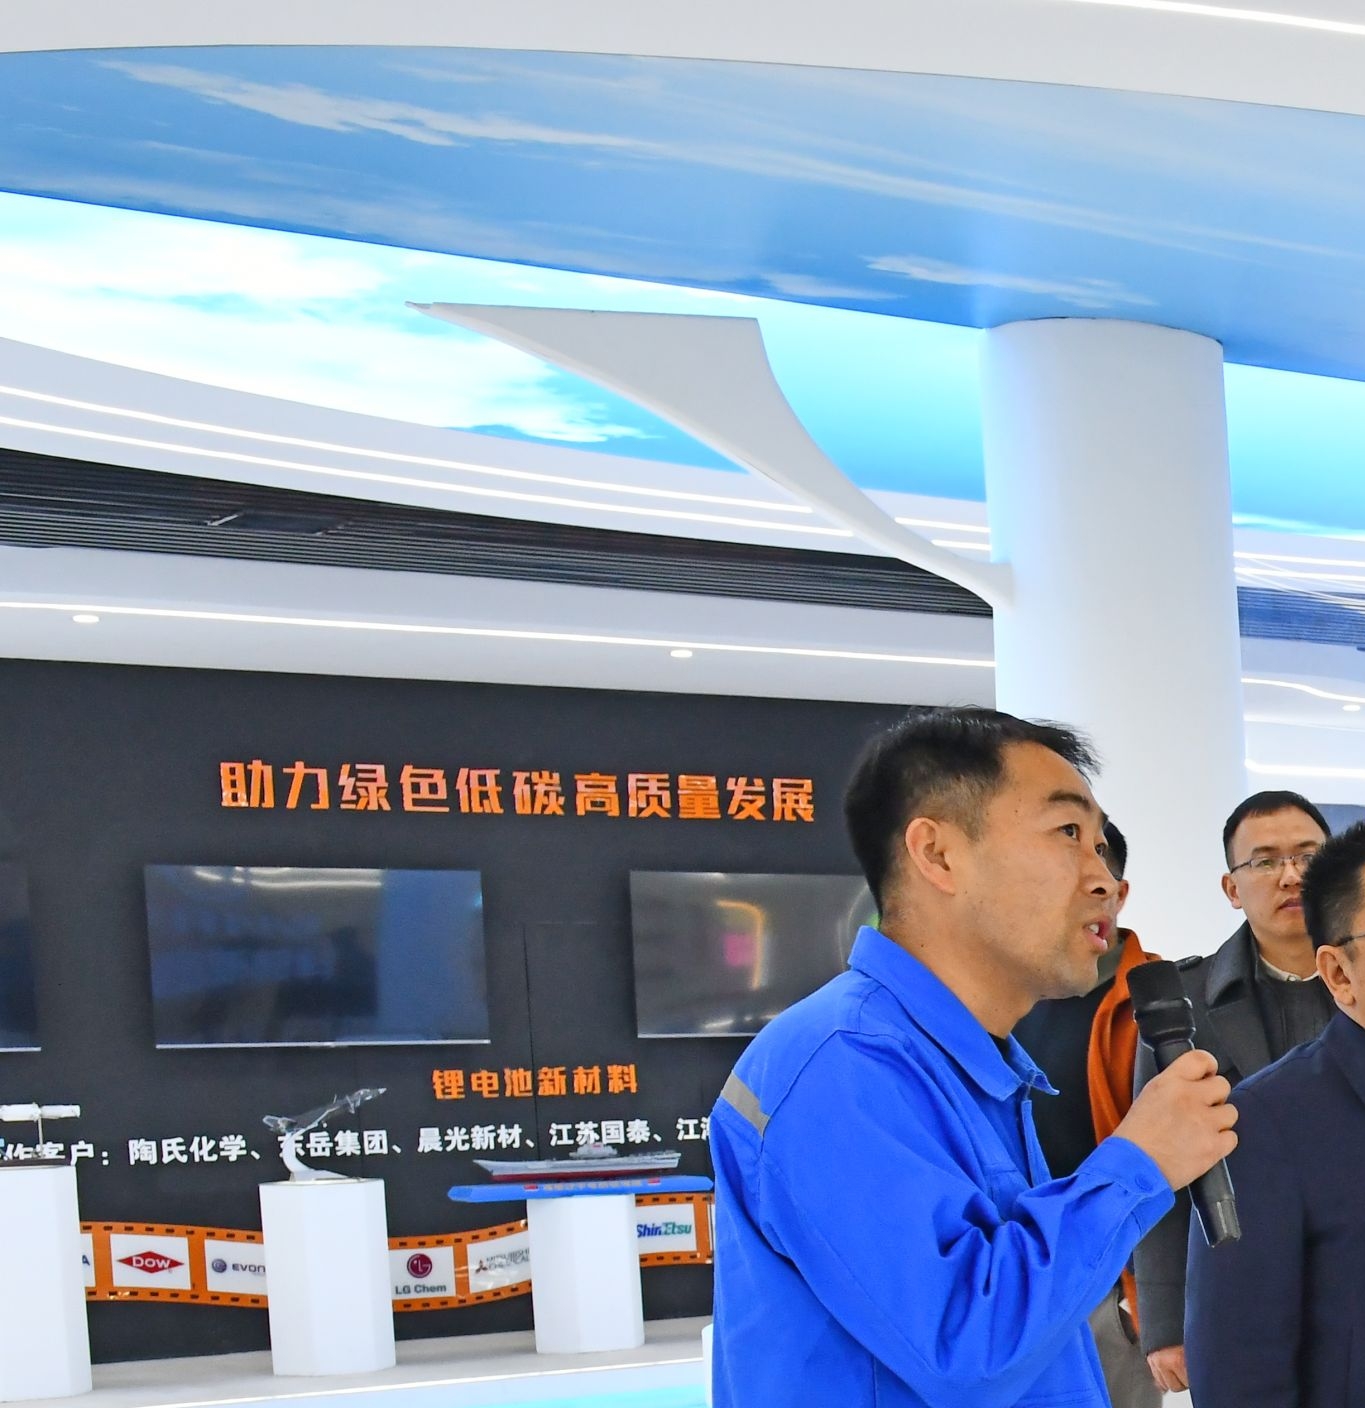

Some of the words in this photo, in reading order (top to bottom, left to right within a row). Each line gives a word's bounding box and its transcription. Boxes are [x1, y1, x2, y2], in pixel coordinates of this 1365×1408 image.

[219, 759, 815, 822] 助力绿色低碳高质量发展
[432, 1064, 638, 1100] 锂电池新材料
[395, 1285, 411, 1295] LG
[414, 1284, 447, 1294] Chem
